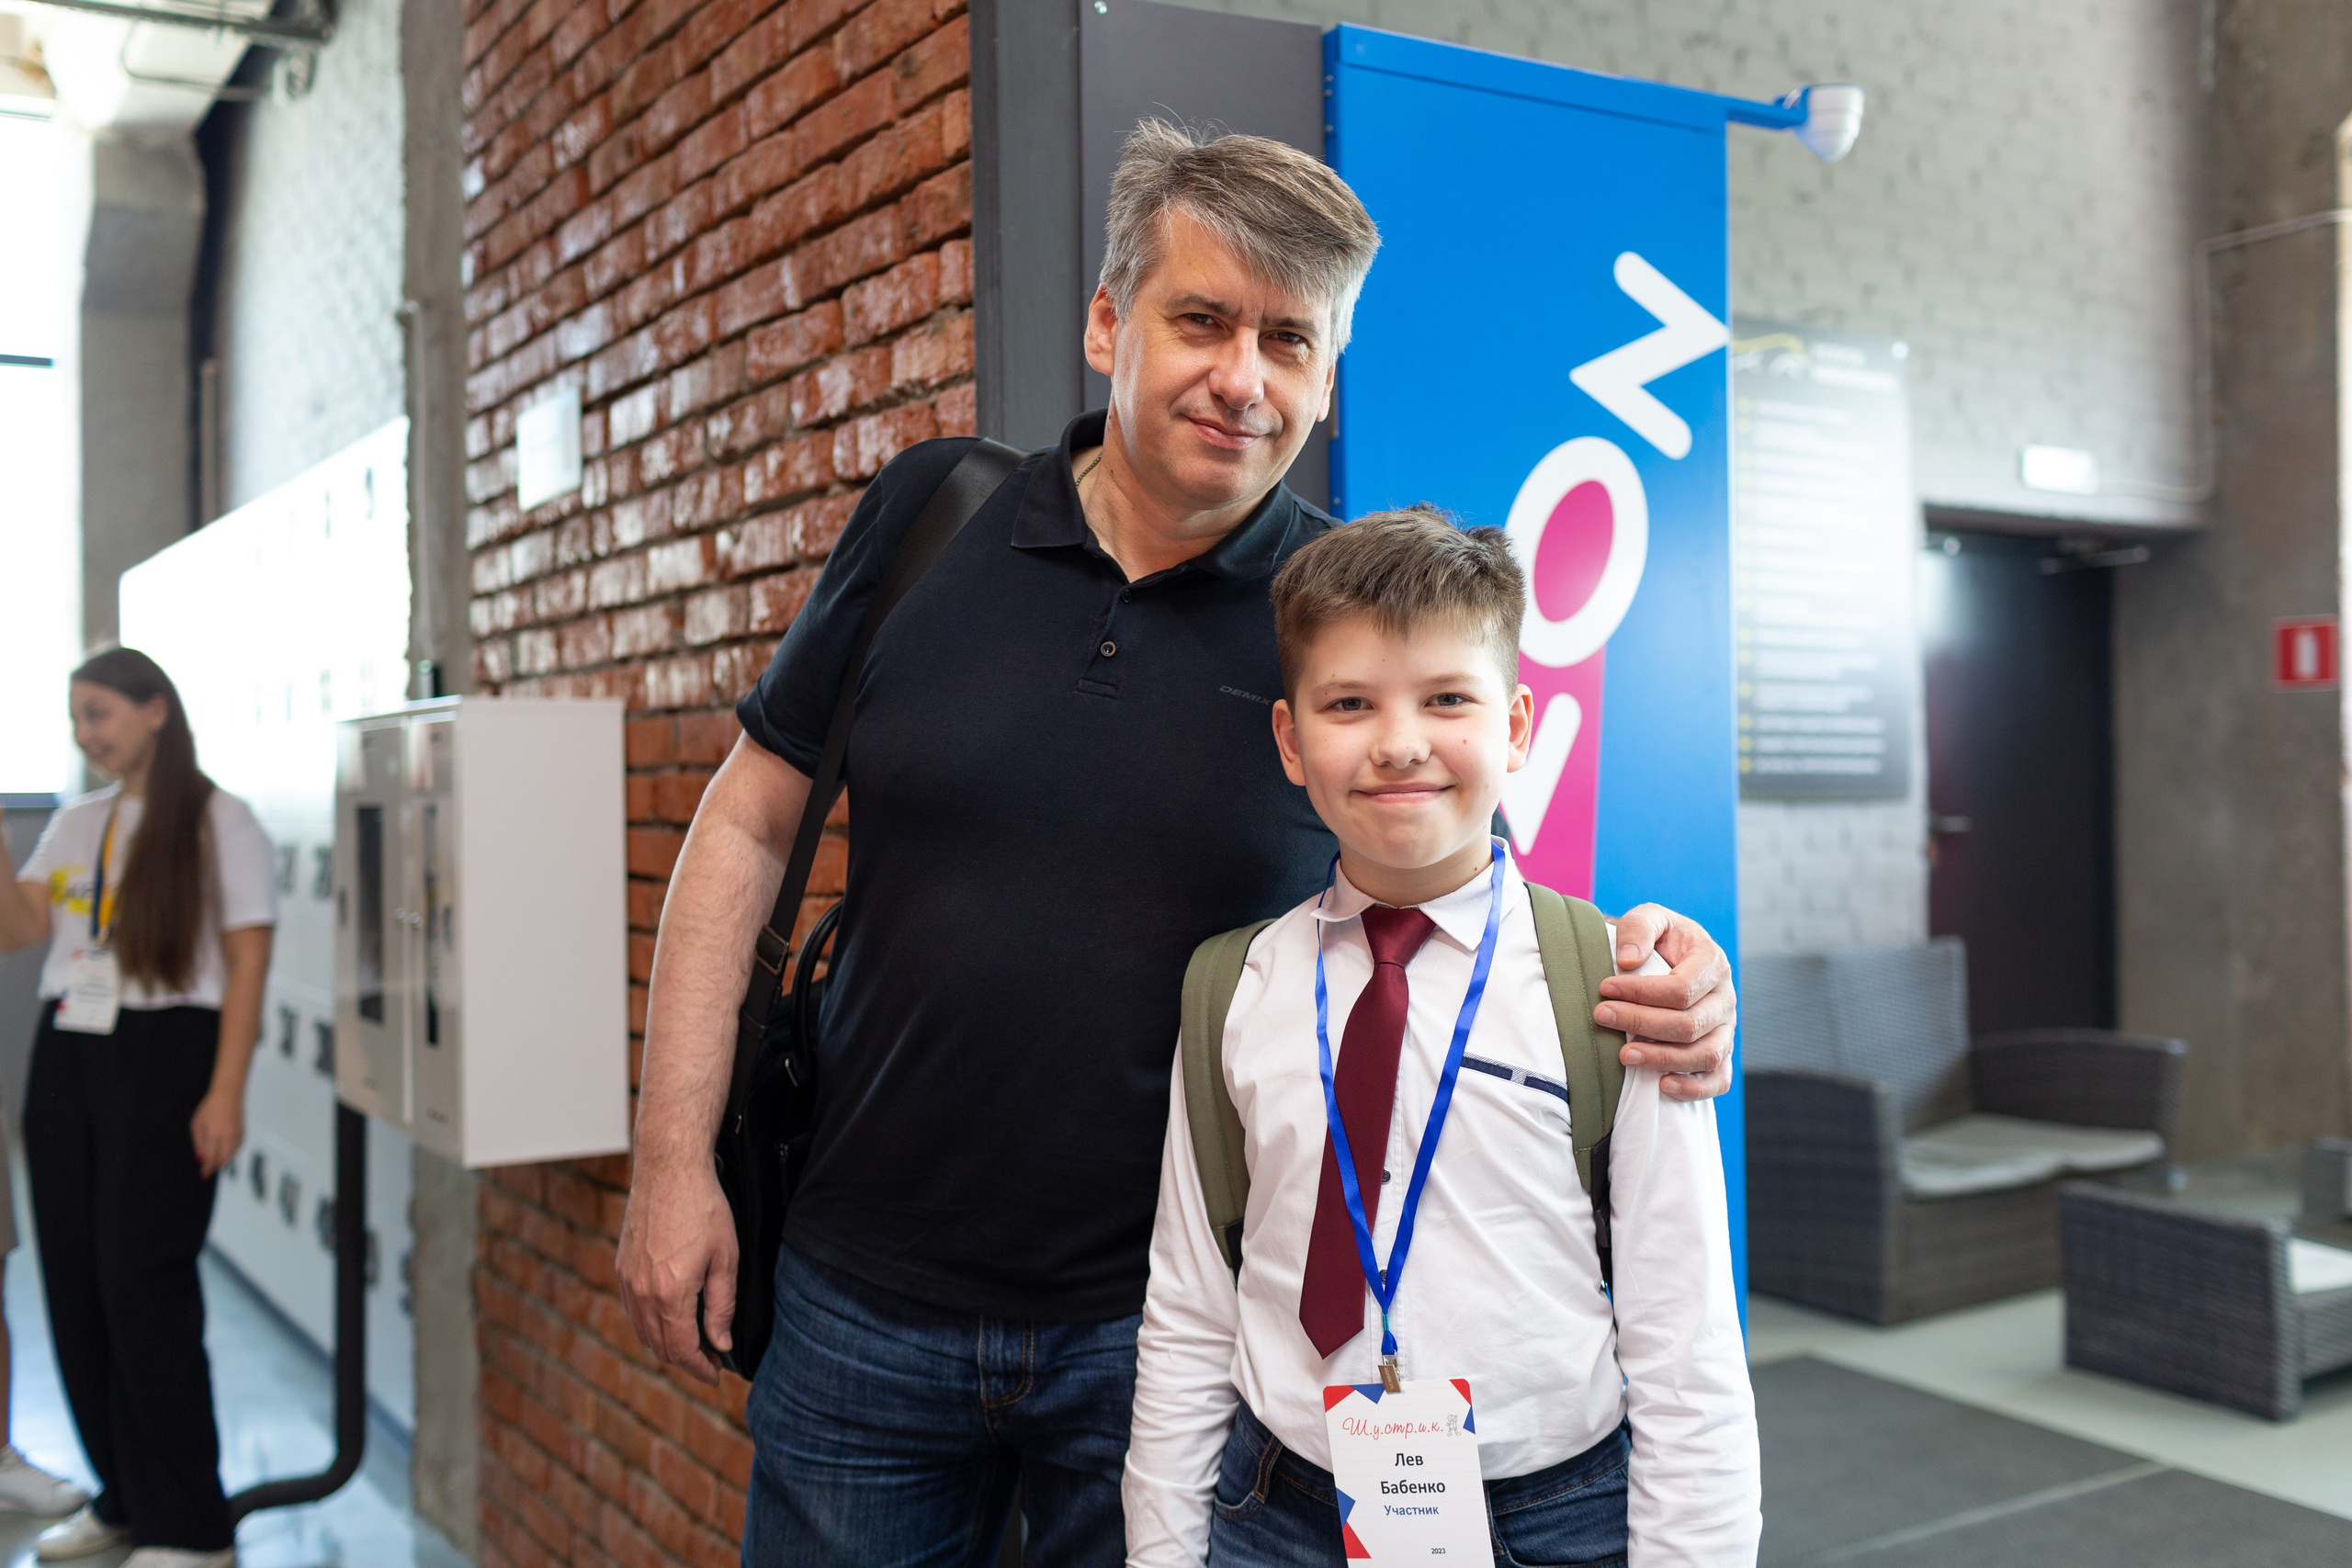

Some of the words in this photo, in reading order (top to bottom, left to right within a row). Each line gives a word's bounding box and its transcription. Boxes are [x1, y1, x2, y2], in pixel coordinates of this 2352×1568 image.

[1218, 684, 1272, 705] DEMIX
[1395, 1453, 1424, 1466] Лев
[1381, 1480, 1446, 1495] Бабенко
[1384, 1505, 1440, 1516] Участник
